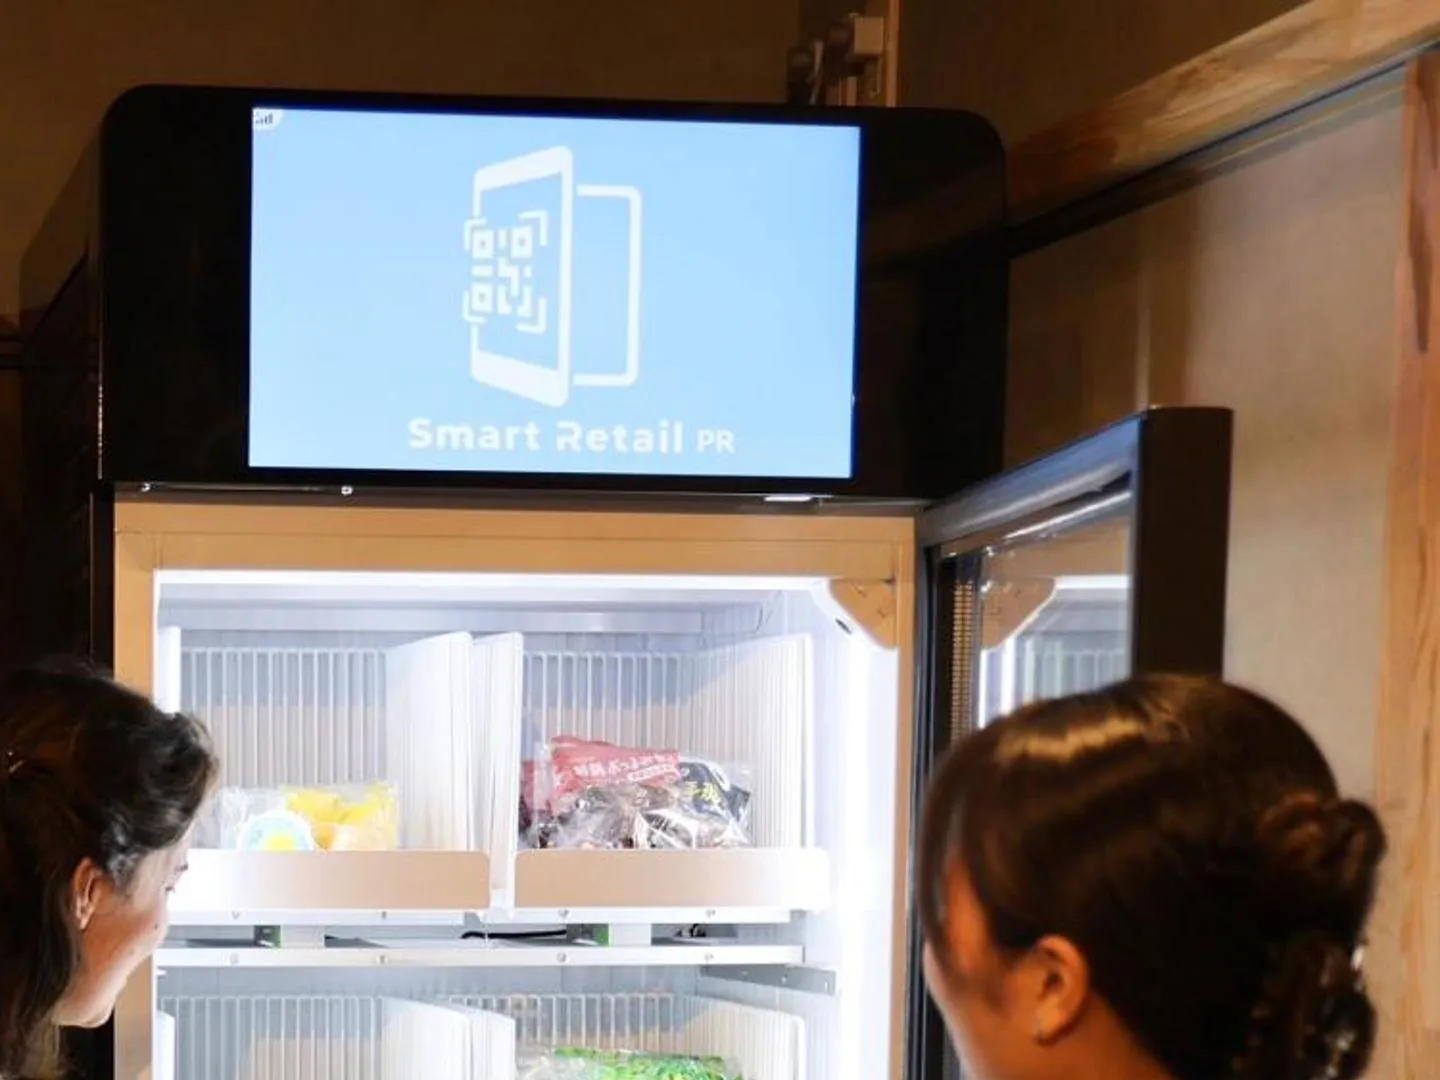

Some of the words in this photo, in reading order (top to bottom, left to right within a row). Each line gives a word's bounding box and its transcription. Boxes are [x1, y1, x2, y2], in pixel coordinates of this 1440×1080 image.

[407, 417, 541, 451] Smart
[556, 419, 684, 454] Retail
[696, 429, 736, 454] PR
